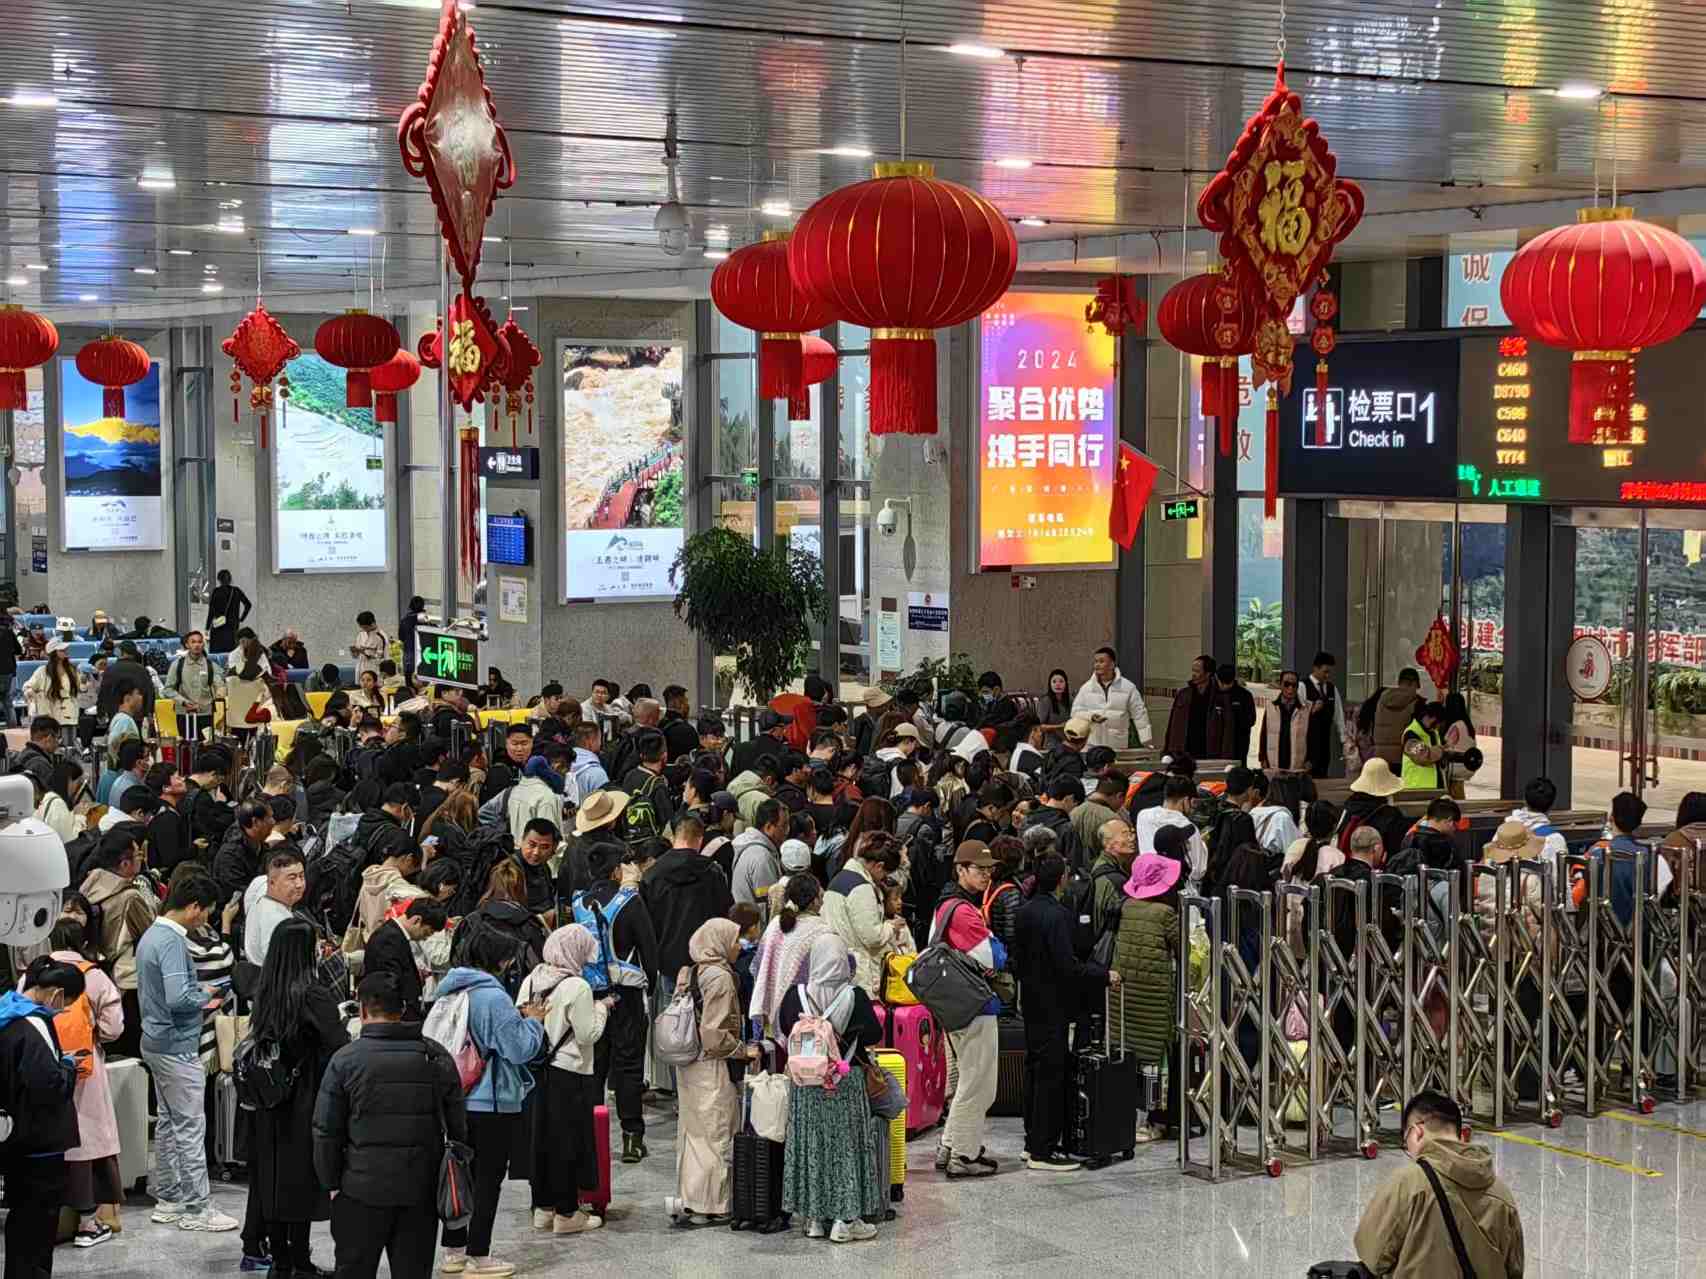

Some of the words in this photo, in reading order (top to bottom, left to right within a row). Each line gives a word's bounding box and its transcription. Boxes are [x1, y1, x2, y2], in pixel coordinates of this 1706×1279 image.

[1259, 158, 1311, 256] 福
[448, 319, 481, 376] 福
[1017, 349, 1077, 369] 2024
[987, 386, 1104, 421] 聚合优势
[1348, 389, 1416, 423] 检票口
[1418, 391, 1435, 444] 1
[987, 433, 1104, 468] 携手同行
[1349, 430, 1390, 448] Check
[1392, 430, 1405, 448] in
